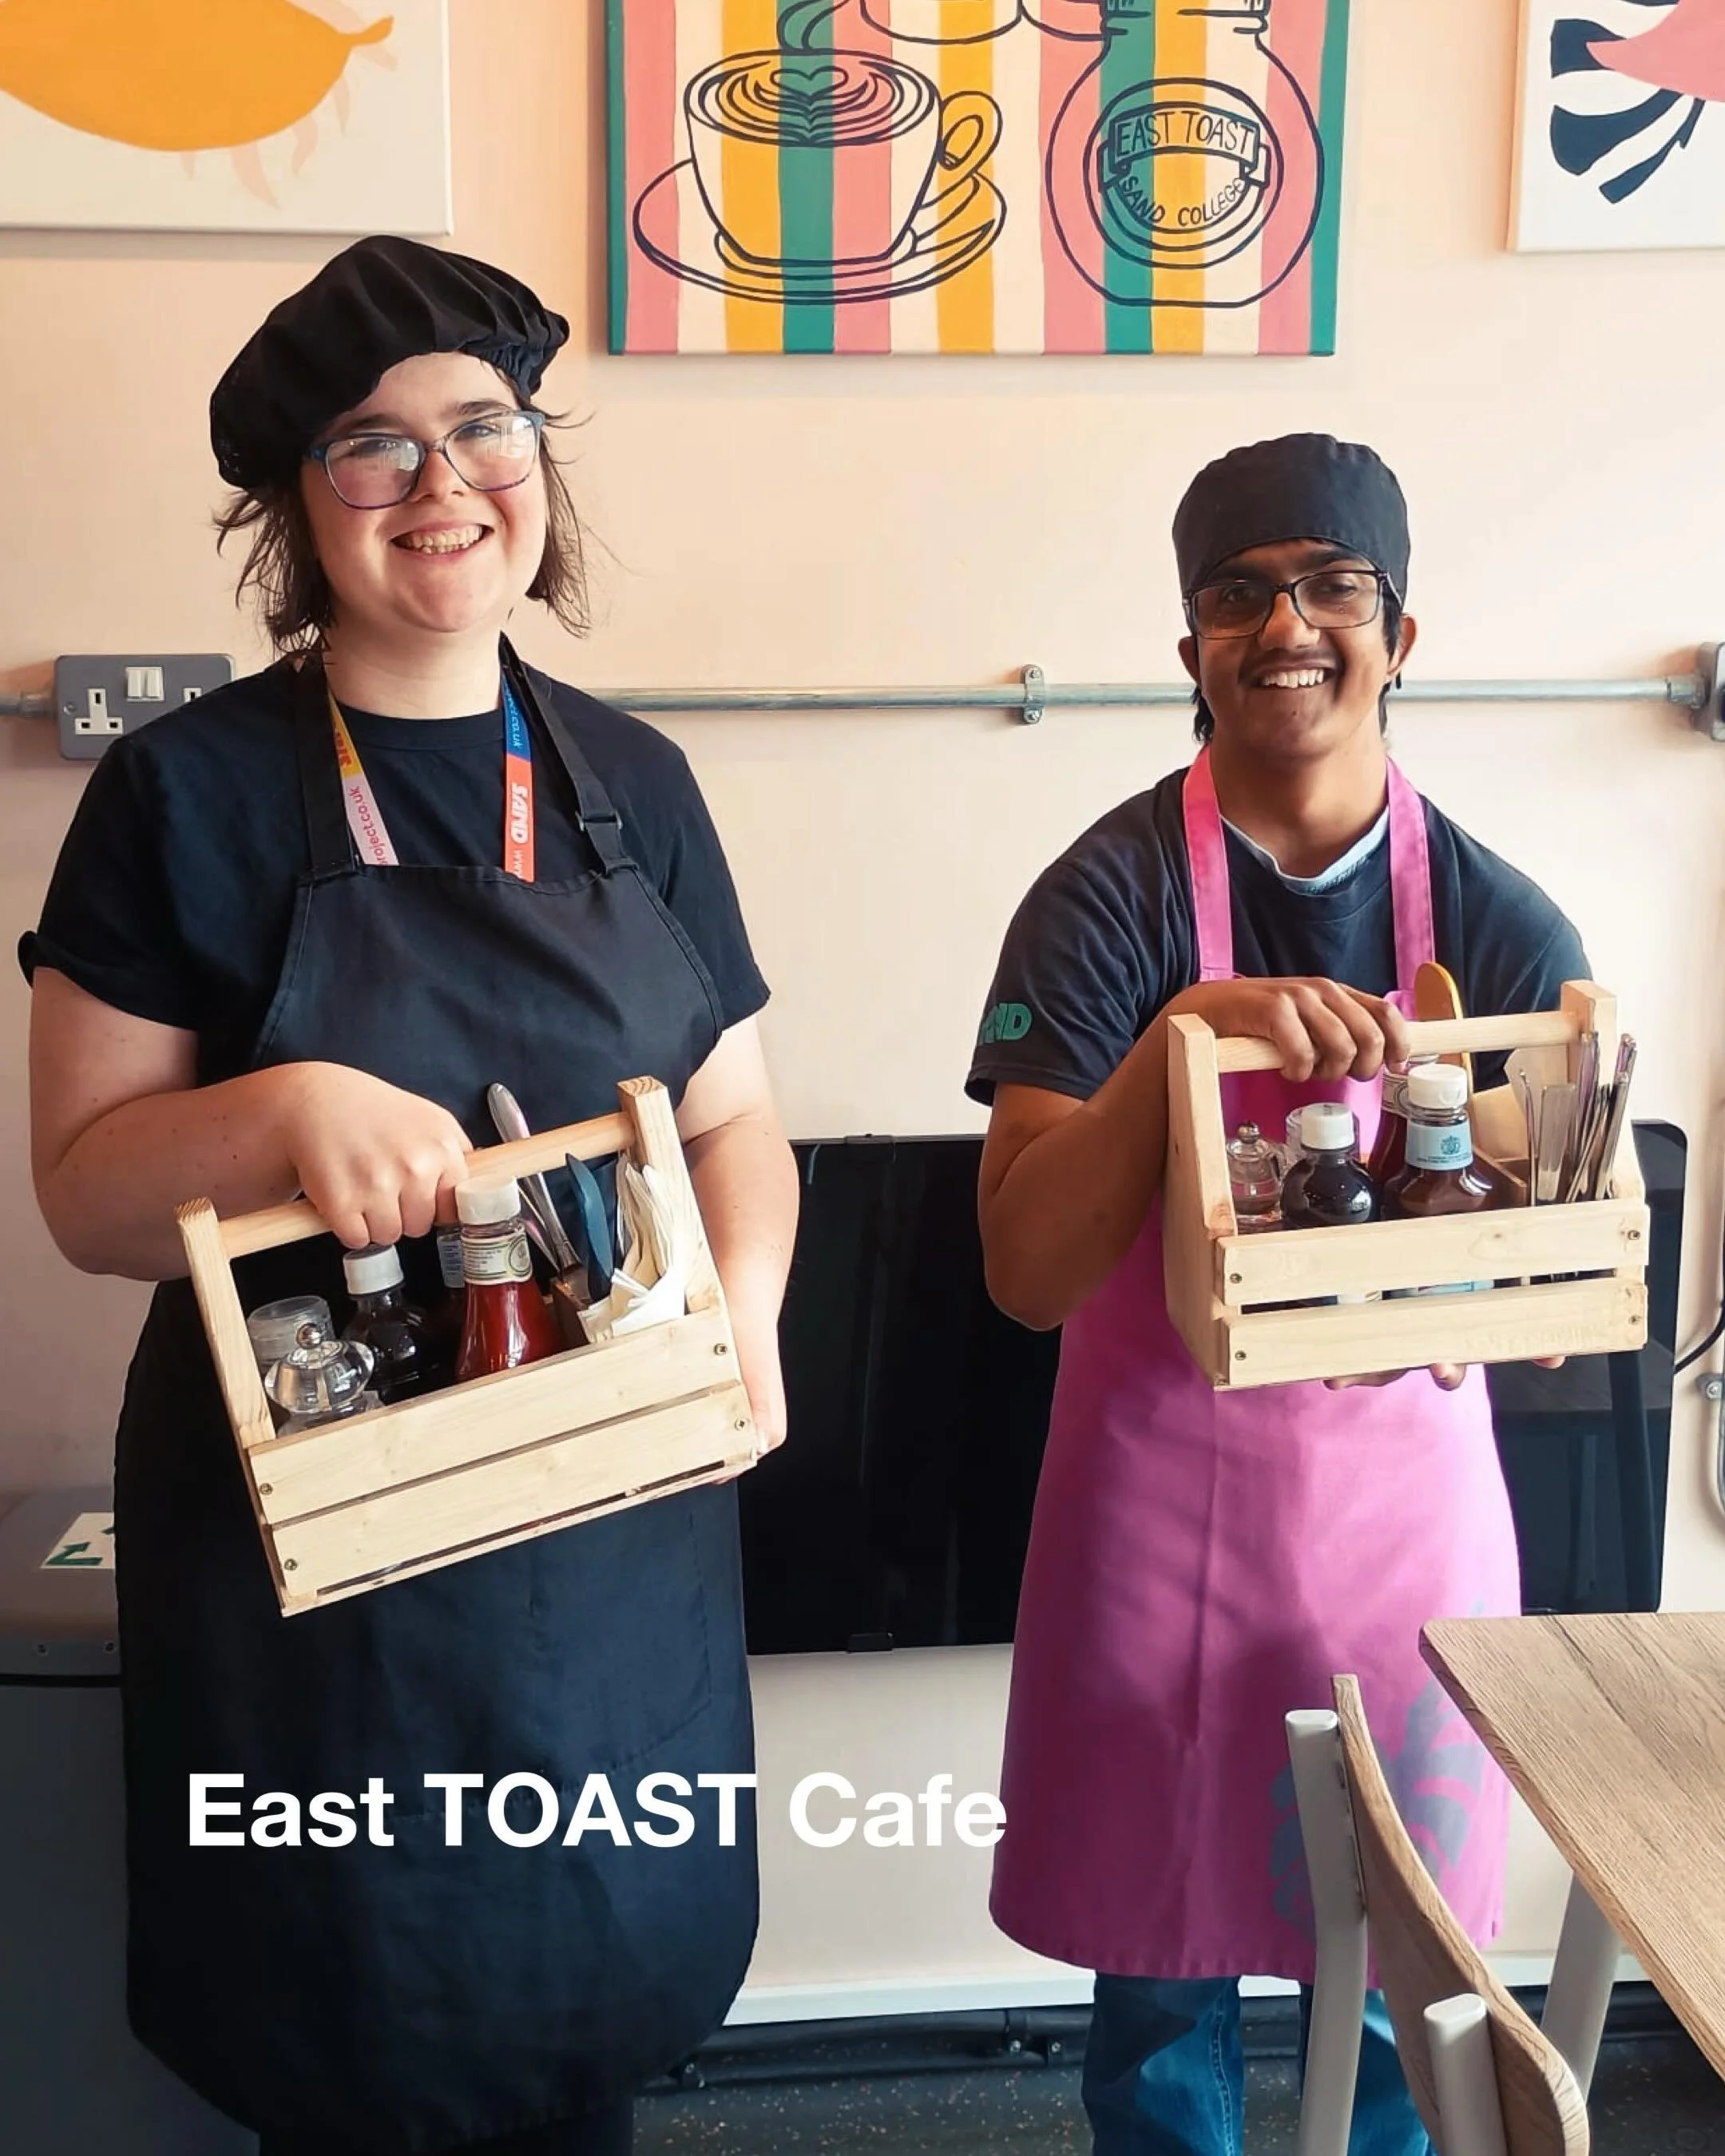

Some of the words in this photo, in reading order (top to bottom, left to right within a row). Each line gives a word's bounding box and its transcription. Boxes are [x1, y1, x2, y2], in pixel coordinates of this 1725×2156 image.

[1118, 111, 1175, 157] EAST
[1181, 110, 1255, 156] TOAST
[1120, 176, 1166, 224] SAND
[1177, 177, 1246, 227] COLLEGE
[510, 782, 529, 845] SAND
